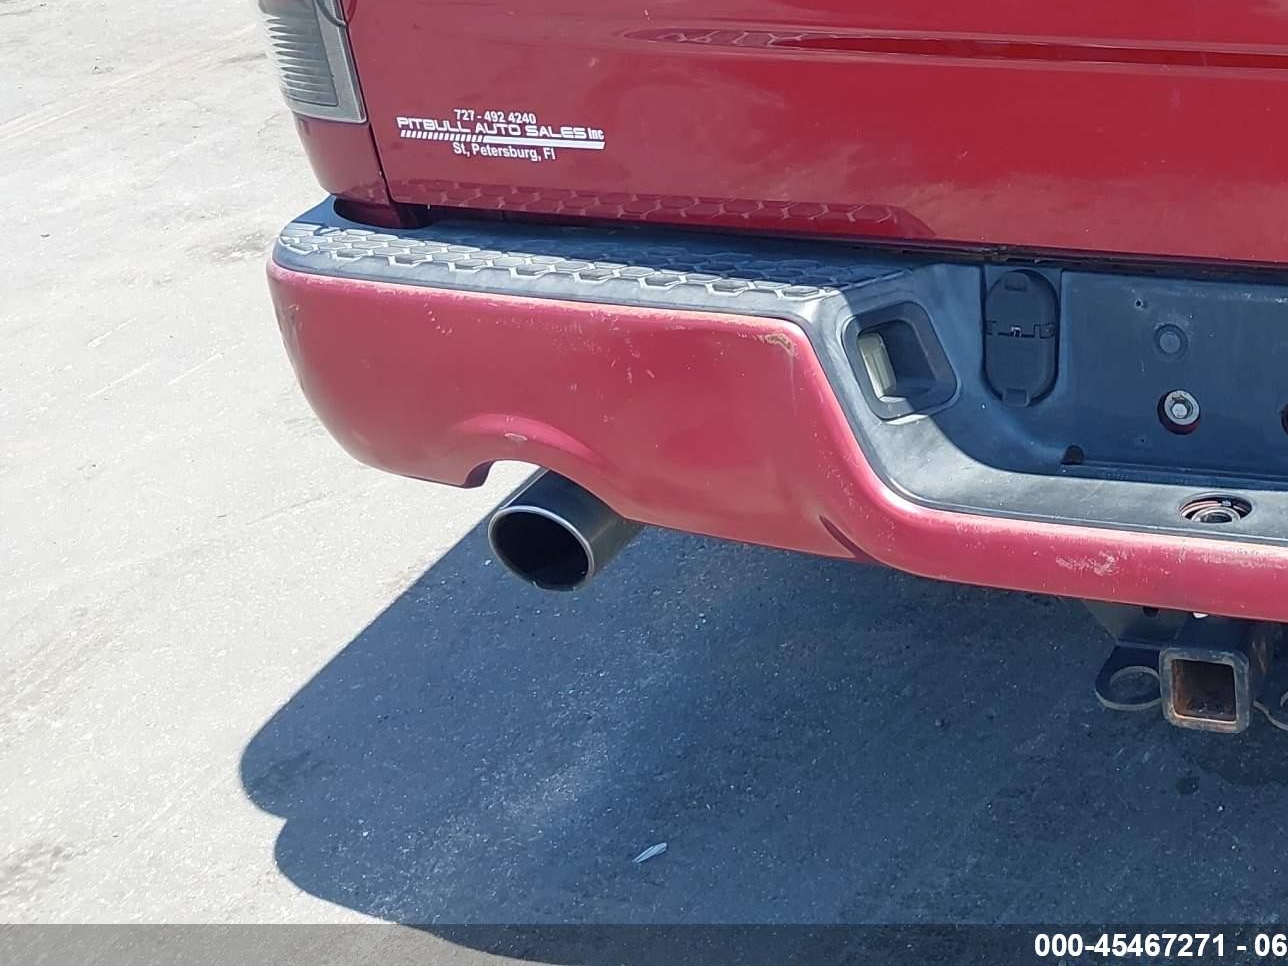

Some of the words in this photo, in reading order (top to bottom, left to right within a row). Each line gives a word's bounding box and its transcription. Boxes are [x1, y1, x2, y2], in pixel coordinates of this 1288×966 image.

[454, 109, 475, 122] 727
[484, 111, 506, 123] 492
[508, 112, 537, 125] 4240
[396, 117, 471, 133] PITBULL
[474, 123, 521, 136] AUTO
[525, 125, 587, 139] SALES
[588, 127, 604, 140] Inc
[472, 143, 542, 162] Petersburg,
